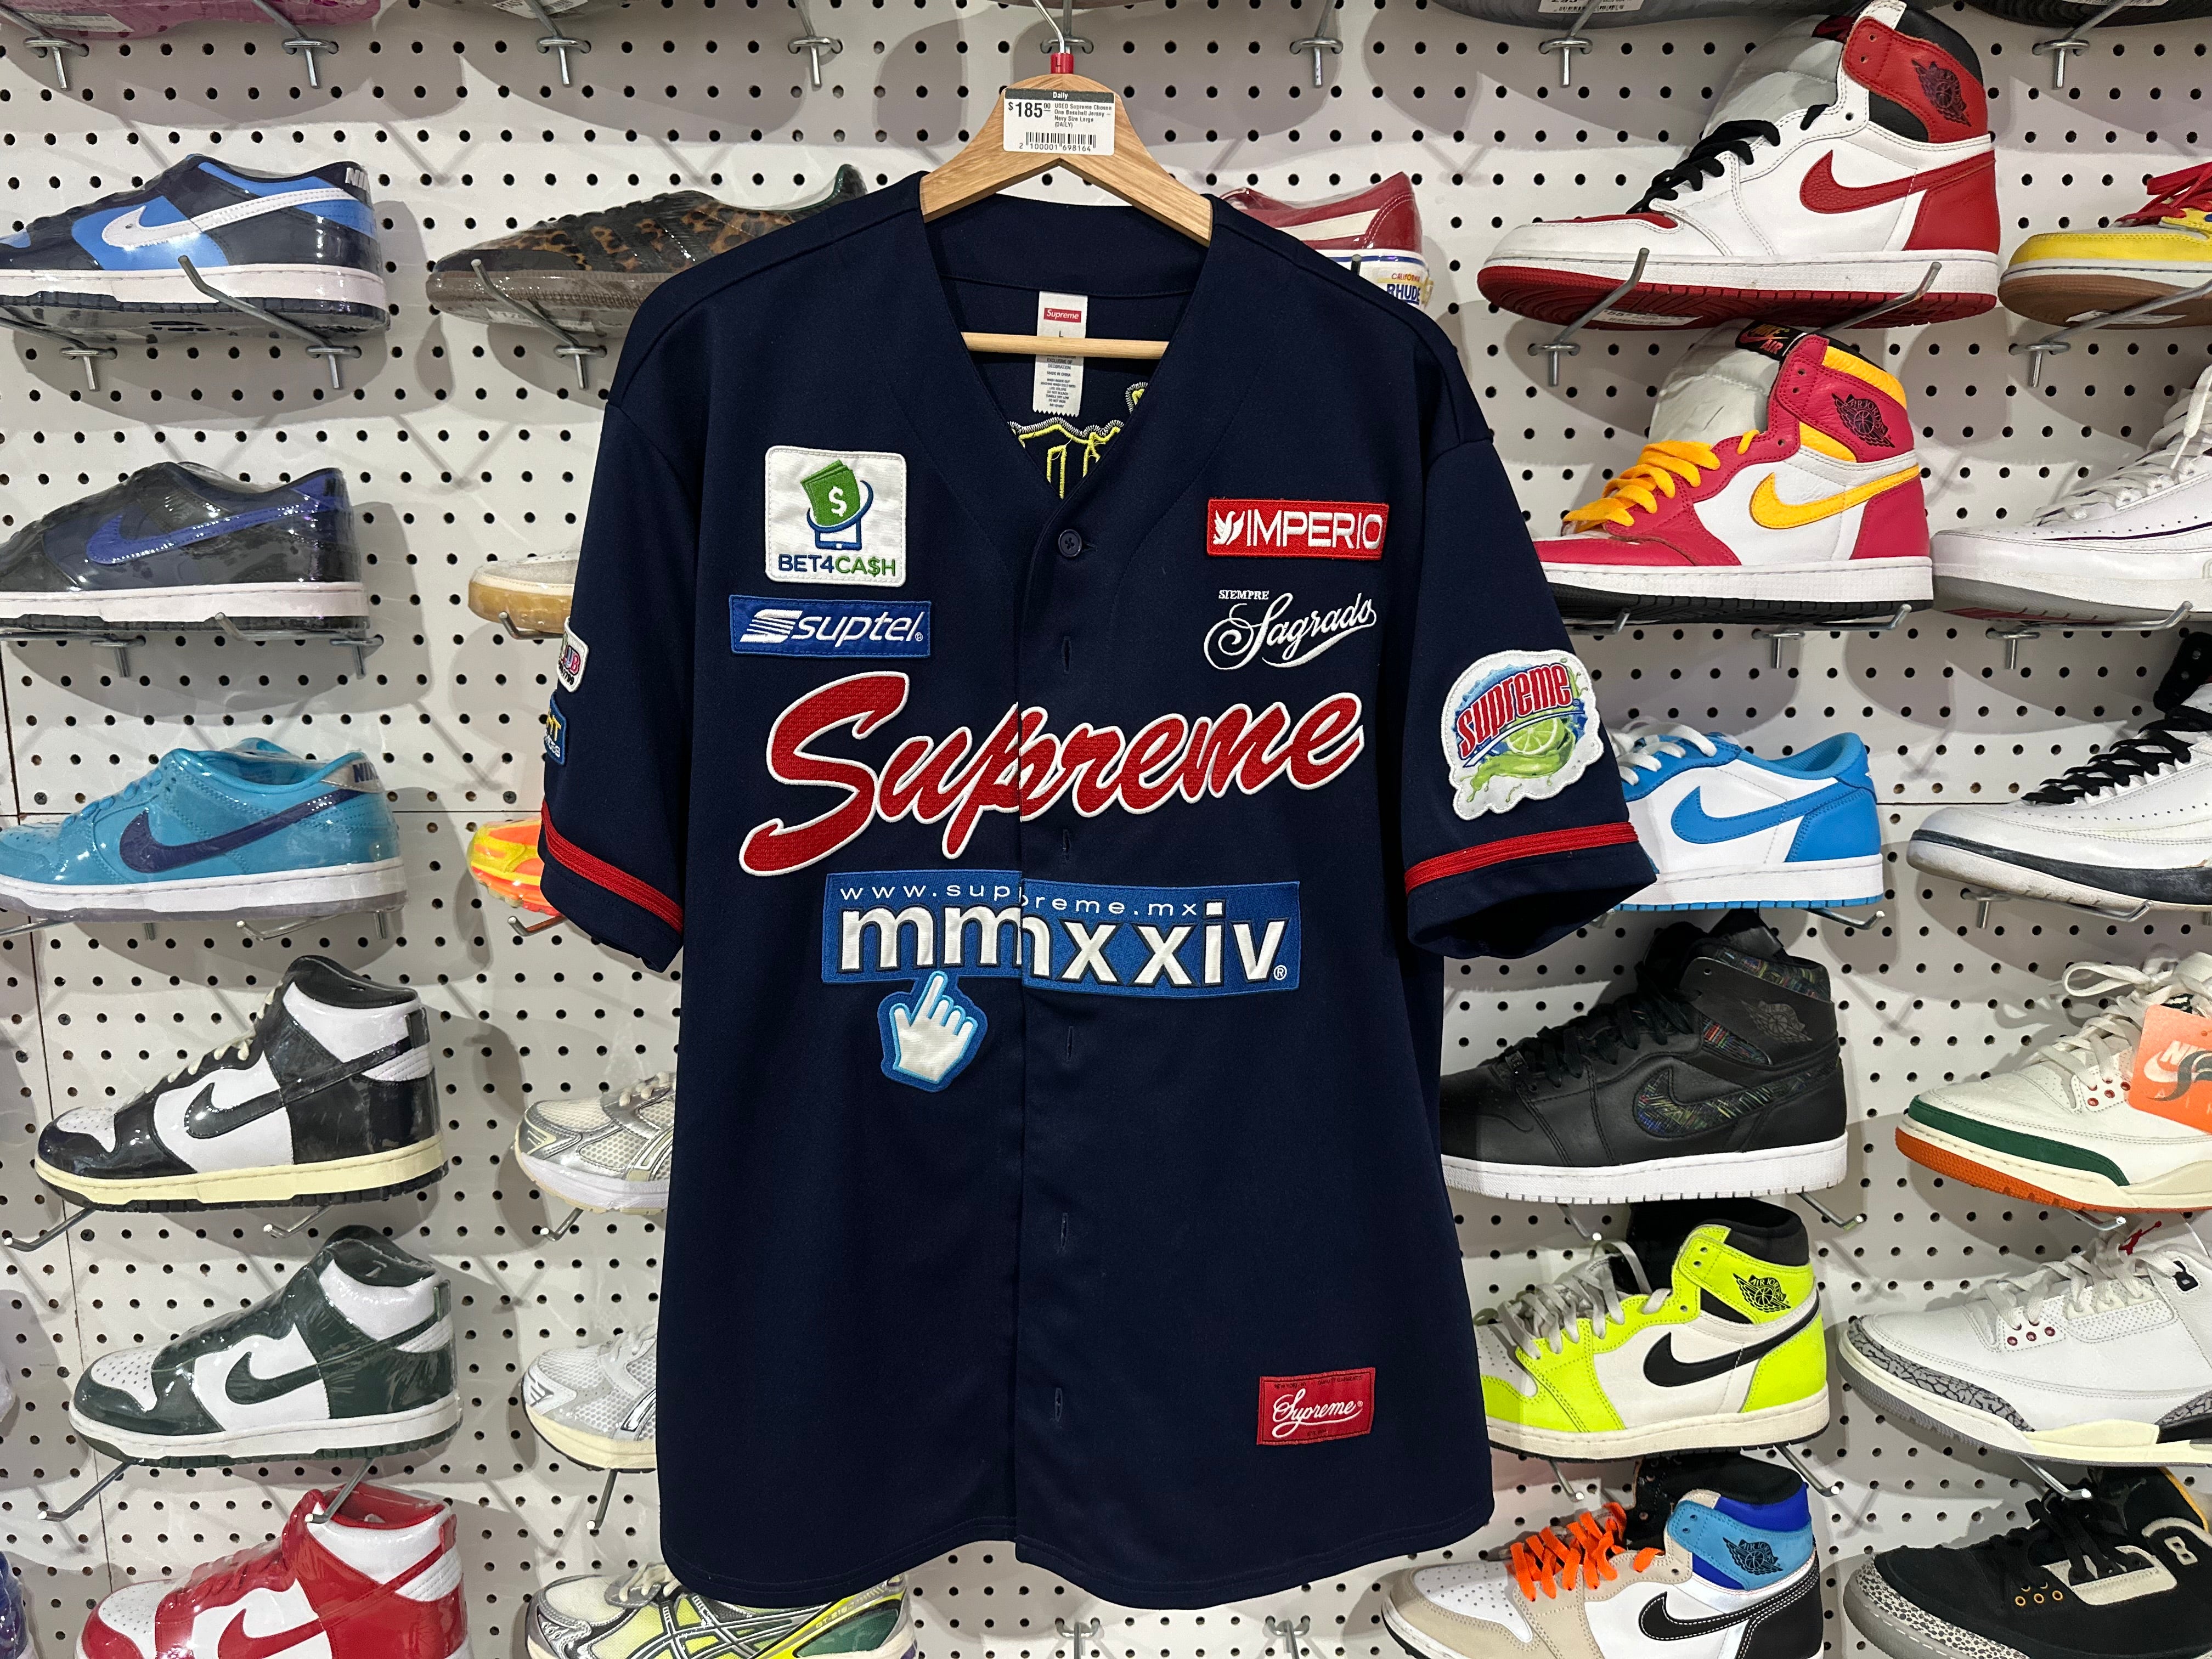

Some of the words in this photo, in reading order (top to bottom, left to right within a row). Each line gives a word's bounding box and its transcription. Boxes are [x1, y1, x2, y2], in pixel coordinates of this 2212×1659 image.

[1053, 92, 1068, 100] Daily
[1046, 309, 1079, 320] Supreme
[1759, 339, 1784, 354] AIR
[1246, 509, 1383, 550] IMPERIO
[778, 554, 896, 578] BET4CA$H
[1218, 590, 1269, 600] SIEMPRE
[1204, 592, 1377, 670] Sagrado
[739, 670, 1365, 877] Supreme
[1767, 1278, 1784, 1301] JORDAN
[1740, 1542, 1755, 1550] AIR
